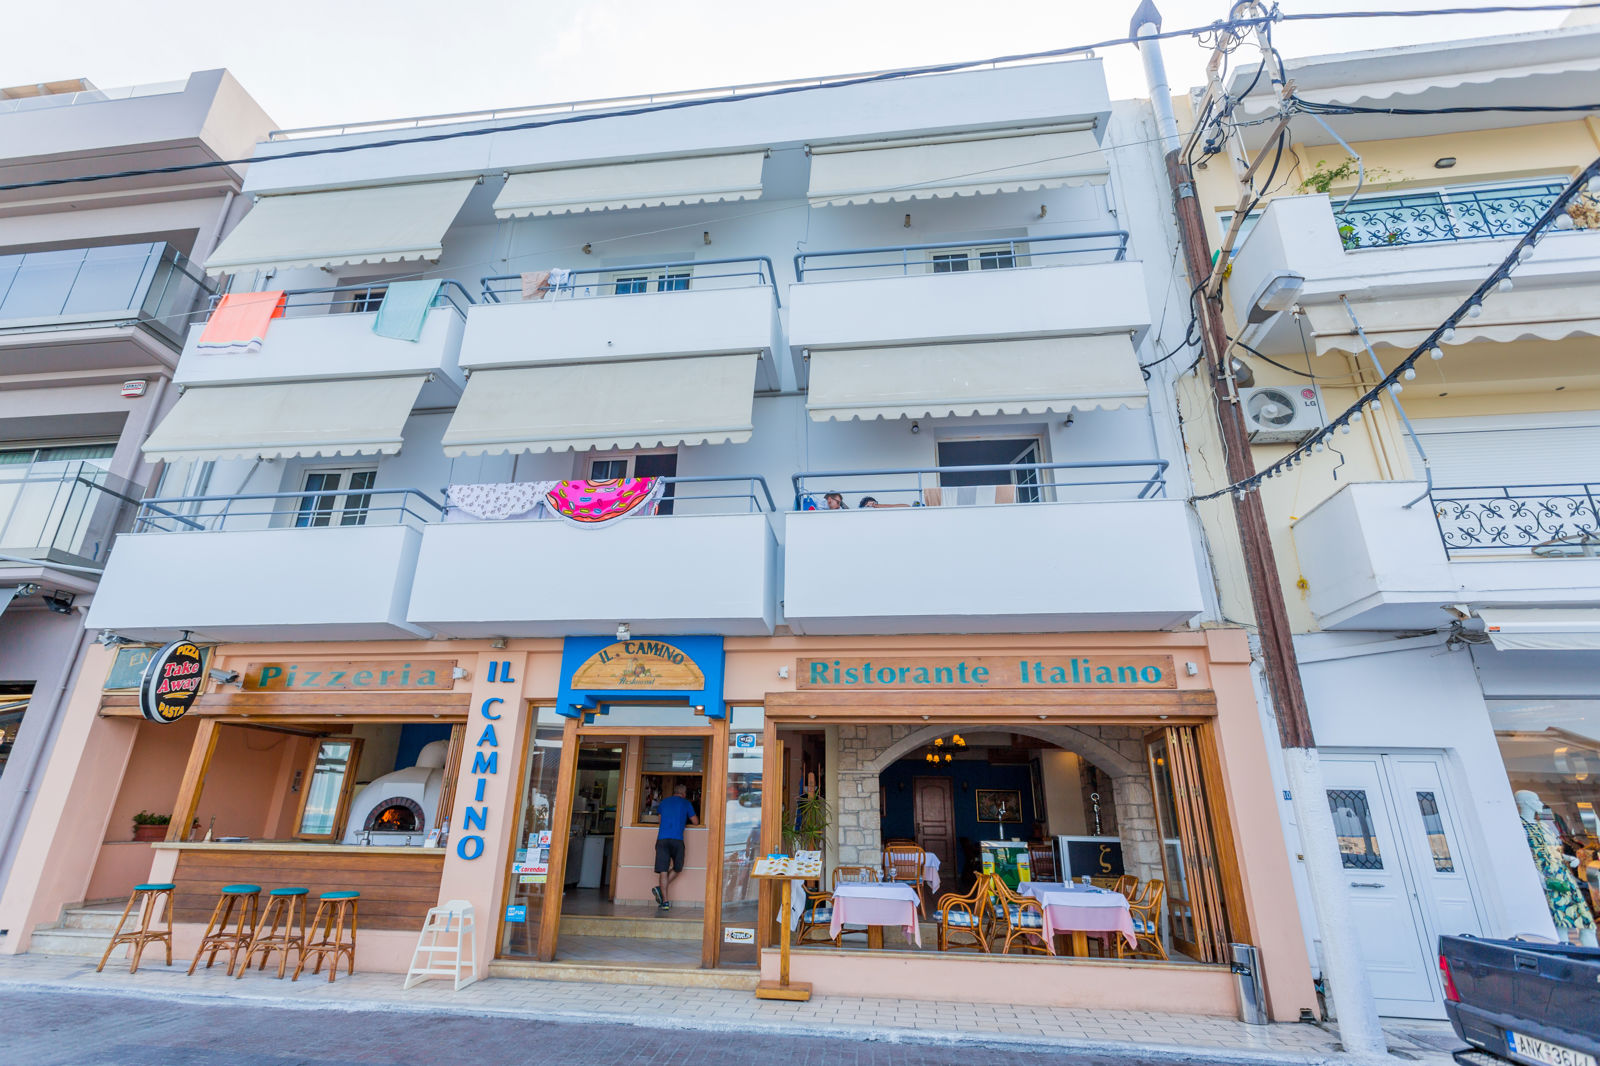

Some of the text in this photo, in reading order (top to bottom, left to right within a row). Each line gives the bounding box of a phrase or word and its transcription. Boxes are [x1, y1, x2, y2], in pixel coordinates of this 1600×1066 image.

[176, 644, 200, 660] PIZZA
[598, 641, 685, 665] IL CAMINO
[164, 661, 200, 678] Take
[258, 663, 438, 688] Pizzeria
[809, 657, 1163, 685] Ristorante Italiano
[157, 676, 202, 693] Away
[158, 701, 185, 718] PASTA
[456, 660, 515, 861] IL CAMINO
